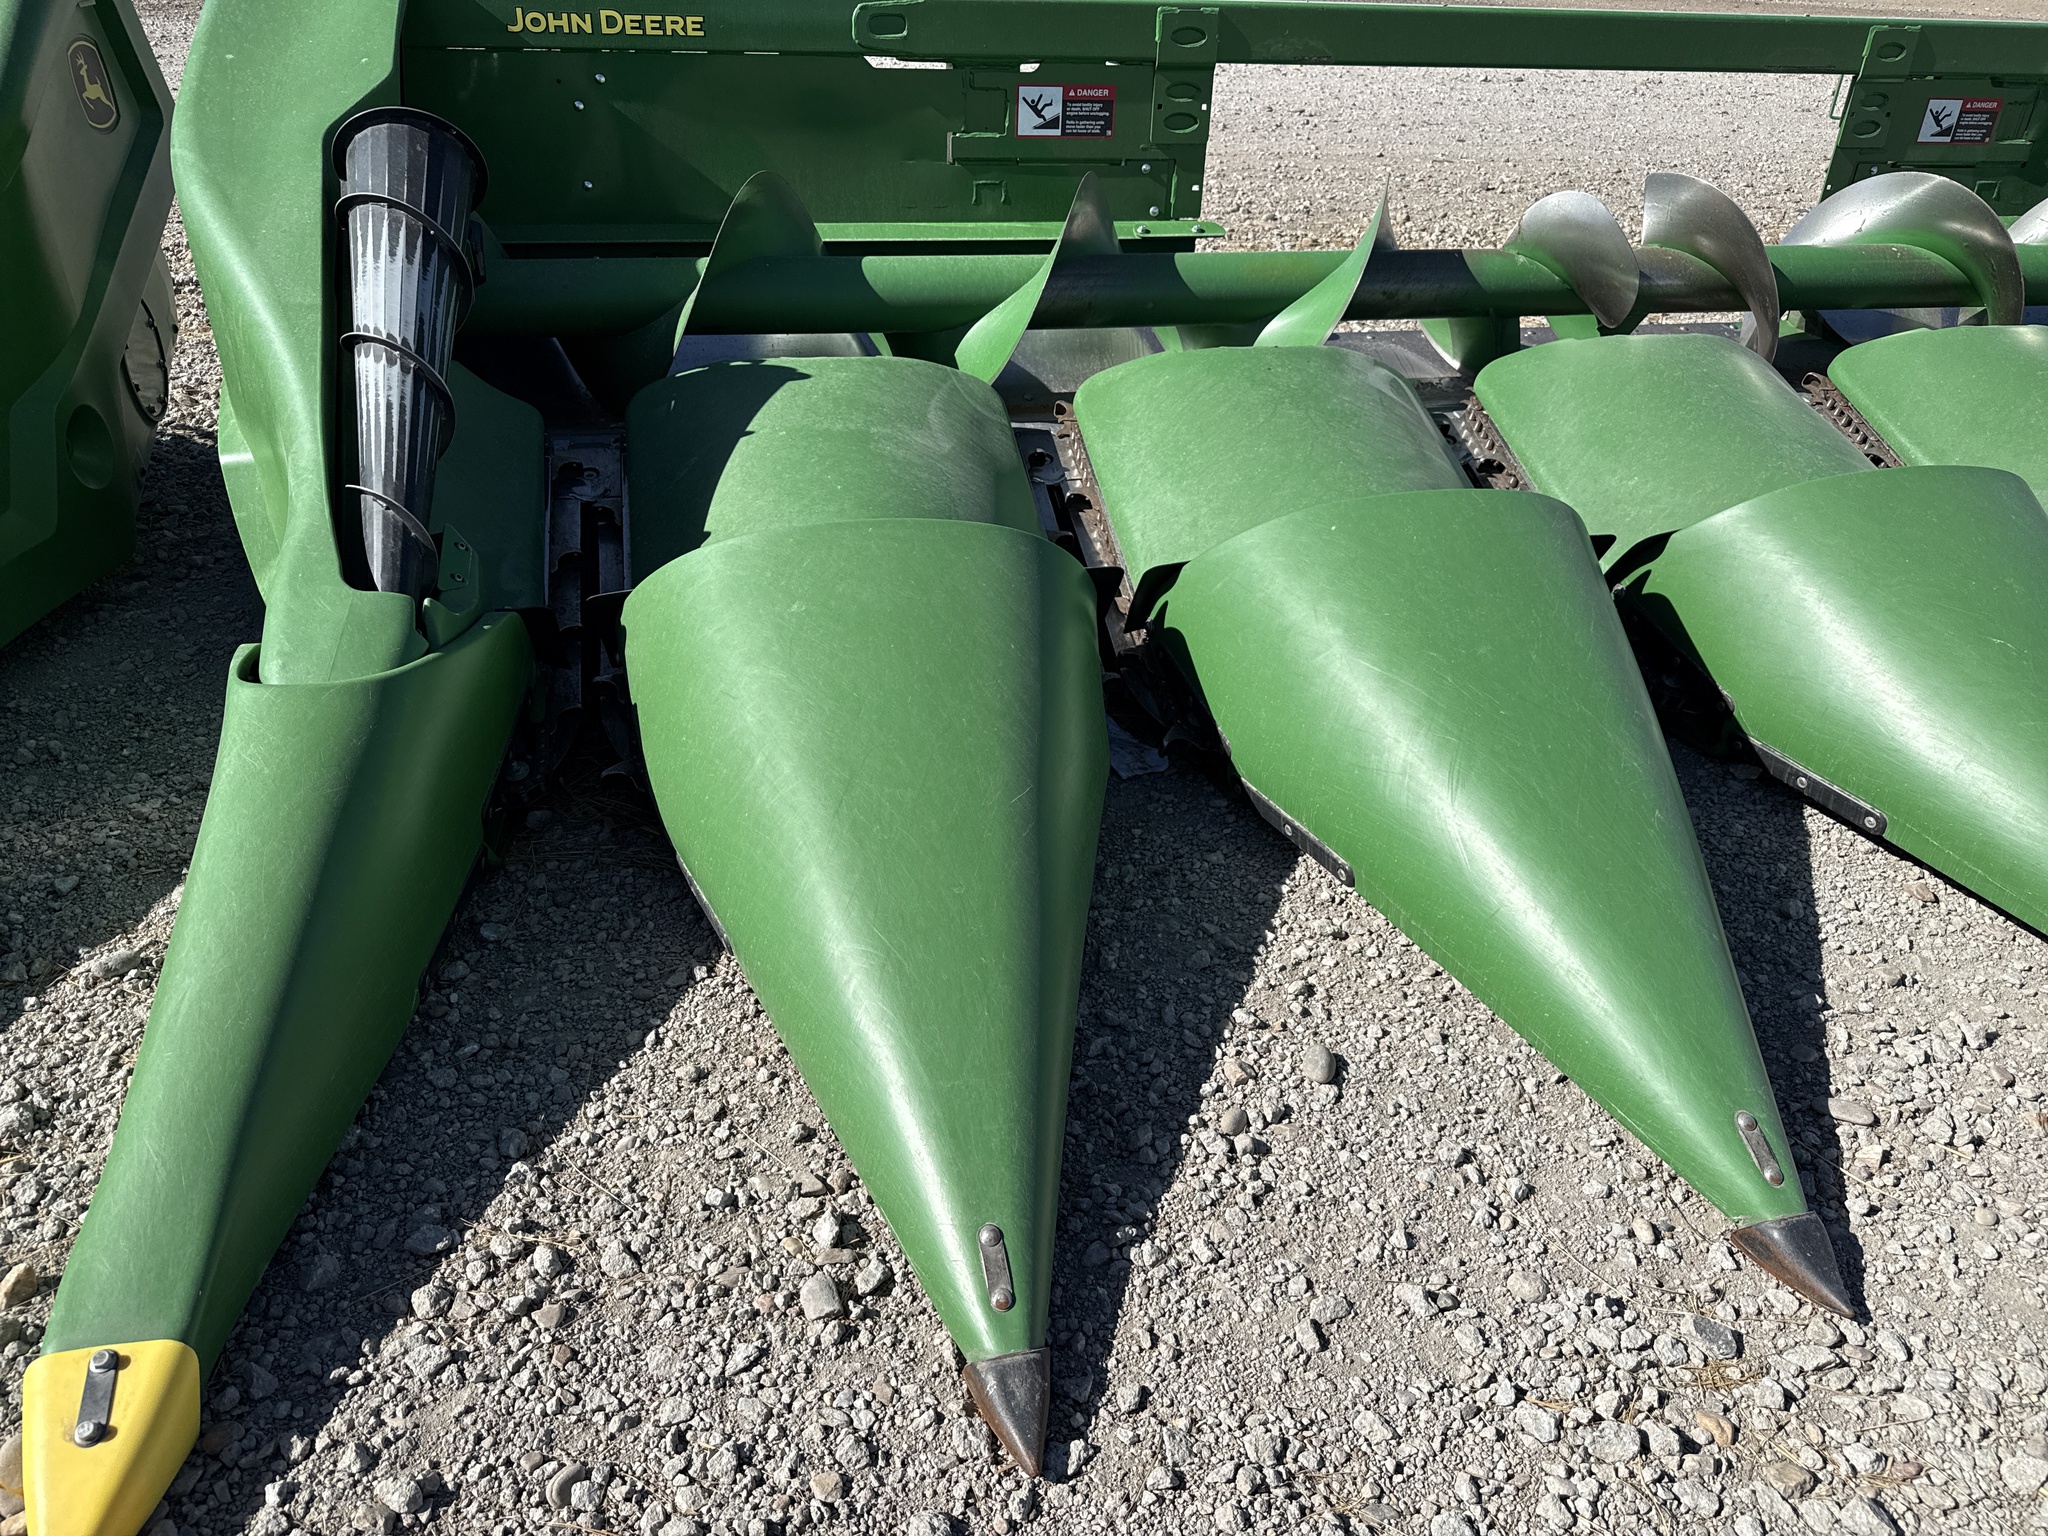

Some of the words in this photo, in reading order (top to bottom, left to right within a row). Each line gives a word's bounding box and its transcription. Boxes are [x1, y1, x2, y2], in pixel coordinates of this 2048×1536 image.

[507, 6, 593, 34] JOHN
[599, 9, 706, 37] DEERE
[1077, 89, 1109, 97] DANGER
